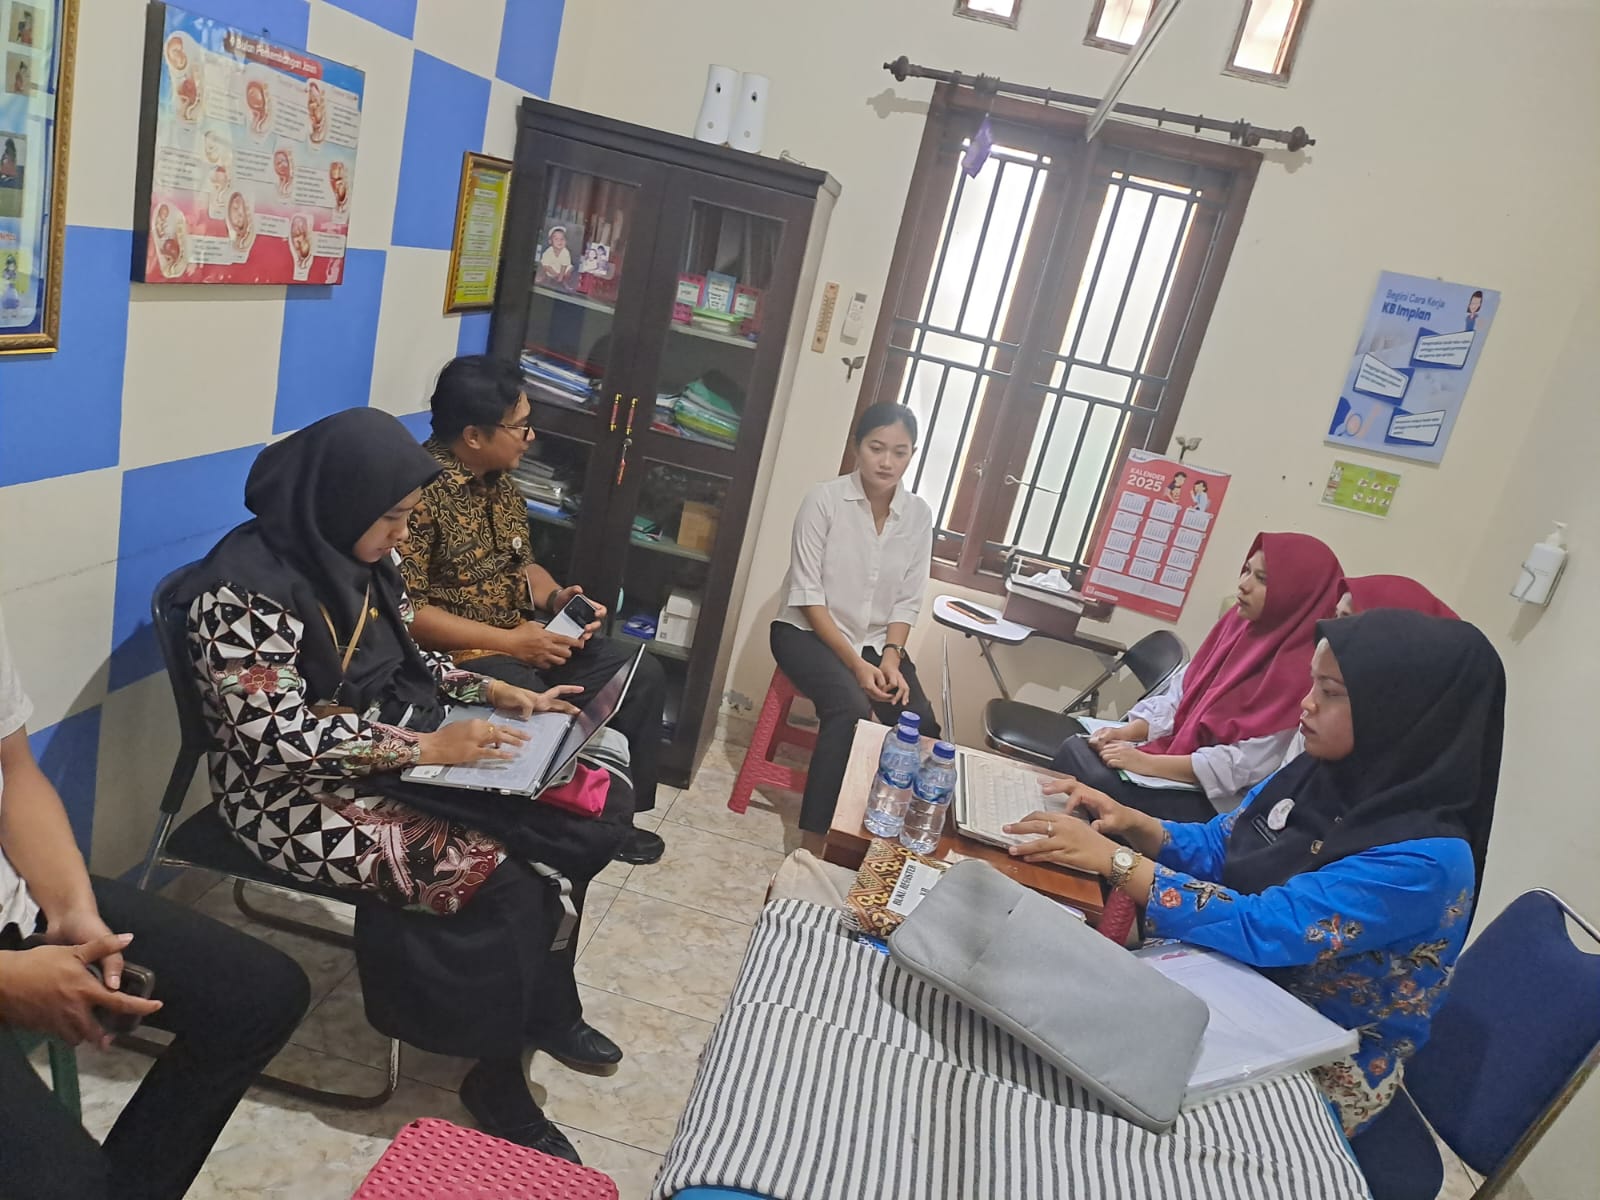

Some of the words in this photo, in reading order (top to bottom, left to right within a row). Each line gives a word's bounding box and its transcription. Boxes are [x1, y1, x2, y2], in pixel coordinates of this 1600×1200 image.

[236, 38, 255, 53] Bulan
[1386, 289, 1408, 302] Begini
[1409, 293, 1426, 305] Cara
[1427, 296, 1446, 310] Kerja
[1381, 301, 1396, 314] KB
[1396, 304, 1432, 321] Implan
[1127, 474, 1163, 492] 2025
[1130, 468, 1165, 481] KALENDER
[899, 864, 917, 890] REGISTER
